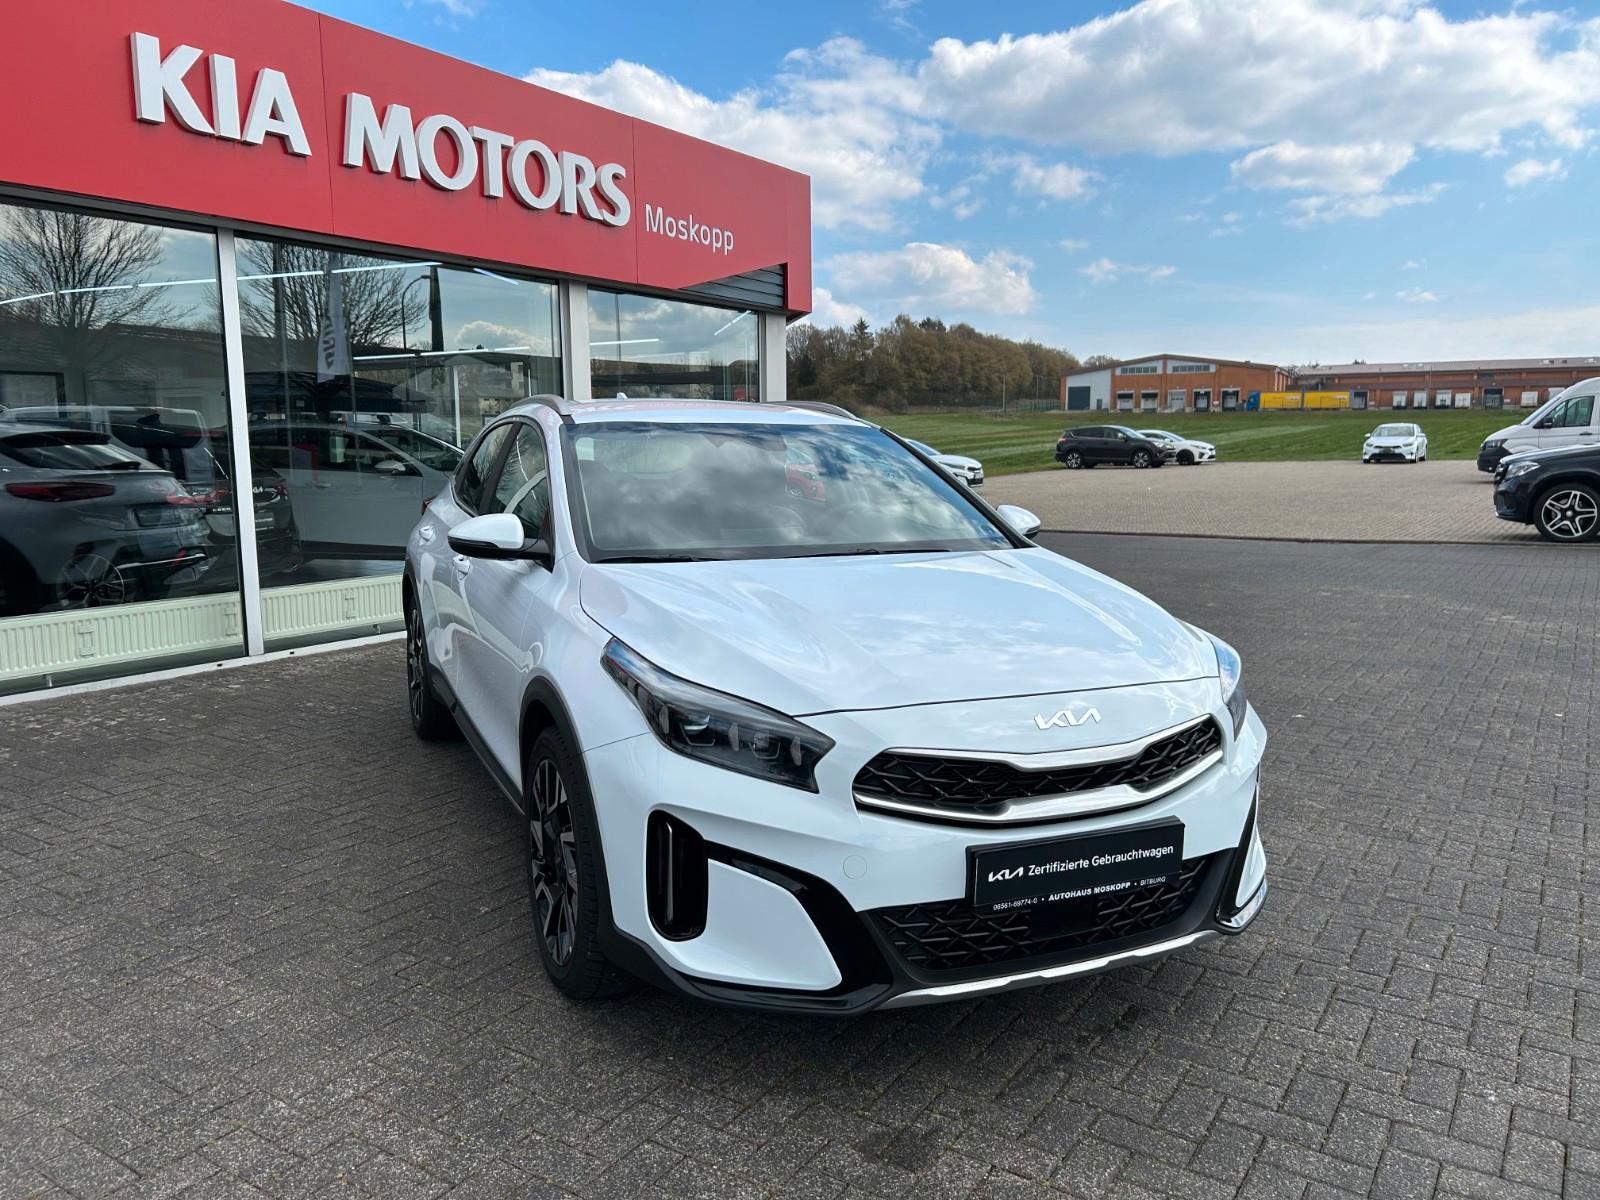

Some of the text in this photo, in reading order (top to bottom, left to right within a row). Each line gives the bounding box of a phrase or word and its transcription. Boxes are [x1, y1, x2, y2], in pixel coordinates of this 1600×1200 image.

[131, 32, 631, 228] KIA MOTORS
[645, 203, 734, 256] Moskopp
[1034, 707, 1102, 730] KIA
[988, 844, 1174, 882] KIA Zertifizierte Gebrauchtwagen
[1048, 888, 1092, 902] AUTOHAUS
[1093, 881, 1131, 894] MOSKOPP
[1139, 876, 1166, 887] BITBURG
